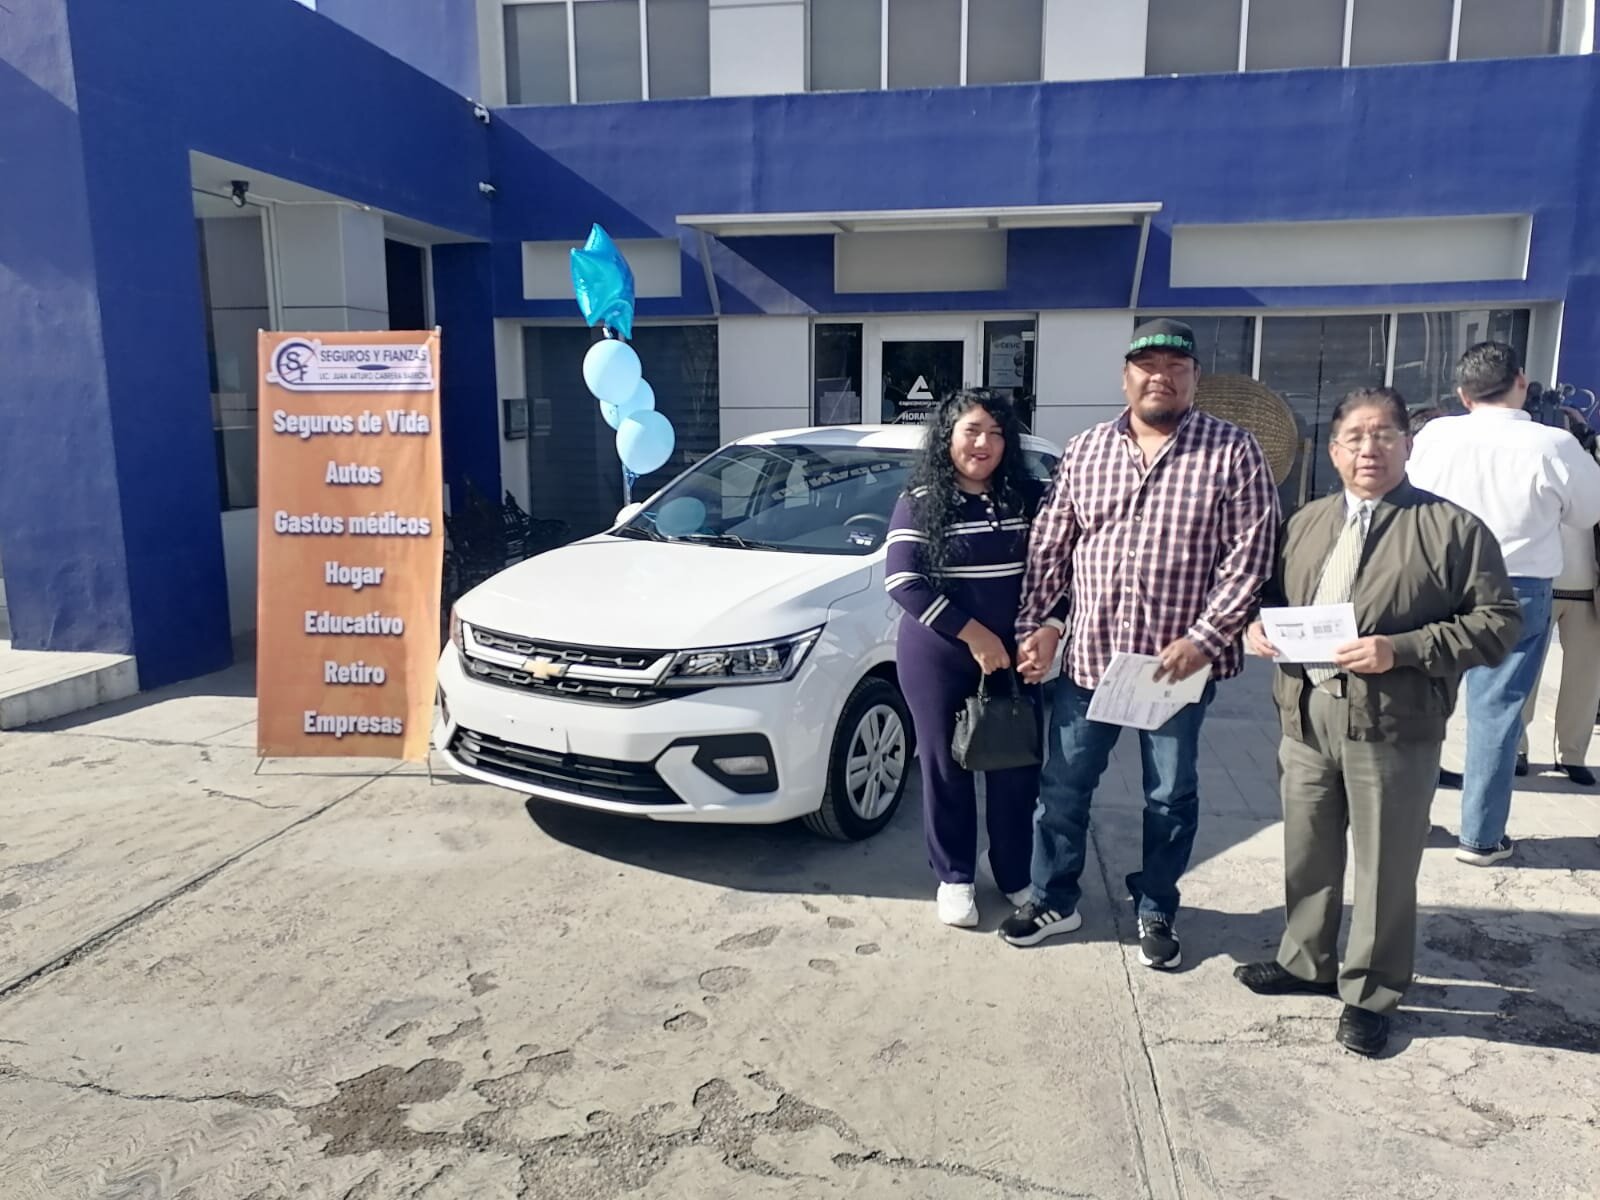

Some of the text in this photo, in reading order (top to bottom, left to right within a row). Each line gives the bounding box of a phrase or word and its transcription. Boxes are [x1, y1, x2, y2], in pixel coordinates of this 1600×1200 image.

[320, 350, 427, 362] SEGUROS Y FIANZAS
[273, 409, 430, 438] Seguros de Vida
[325, 461, 382, 484] Autos
[274, 511, 431, 536] Gastos médicos
[325, 561, 384, 590] Hogar
[304, 610, 404, 635] Educativo
[324, 660, 386, 684] Retiro
[303, 710, 403, 738] Empresas
